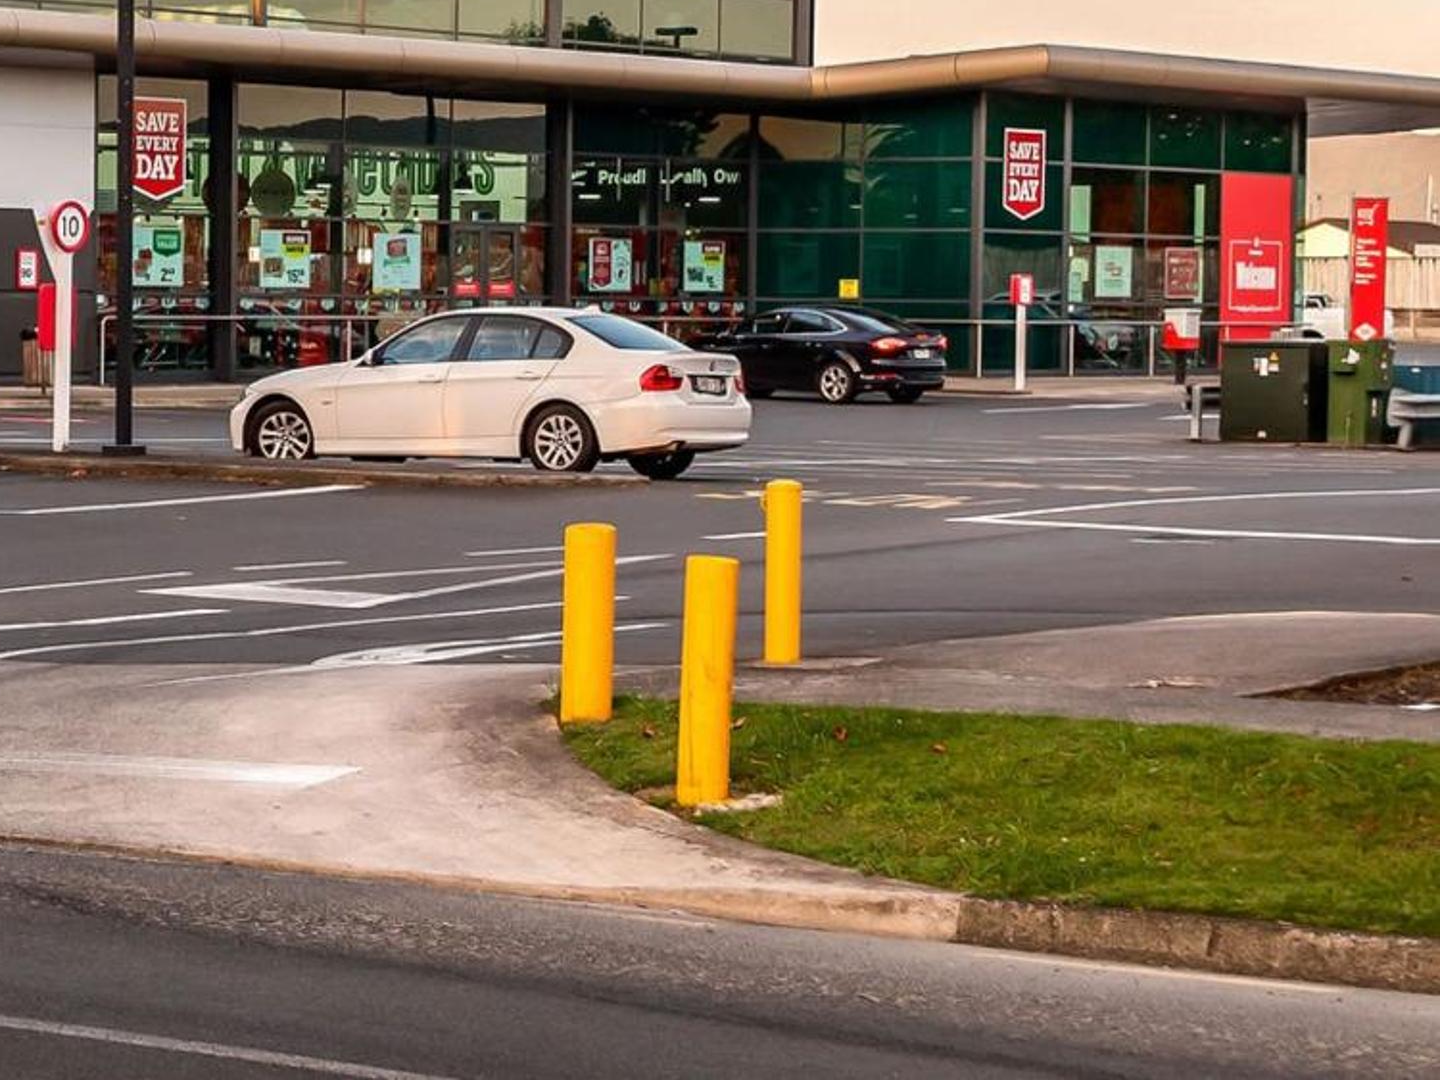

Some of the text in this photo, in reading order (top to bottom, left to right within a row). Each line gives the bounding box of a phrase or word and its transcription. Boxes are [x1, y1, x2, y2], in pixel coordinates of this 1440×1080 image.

[135, 111, 180, 133] SAVE
[135, 135, 178, 153] EVERY
[1009, 141, 1040, 161] SAVE
[135, 154, 179, 181] DAY
[1009, 162, 1040, 178] EVERY
[1008, 180, 1039, 203] DAY
[59, 215, 80, 238] 10
